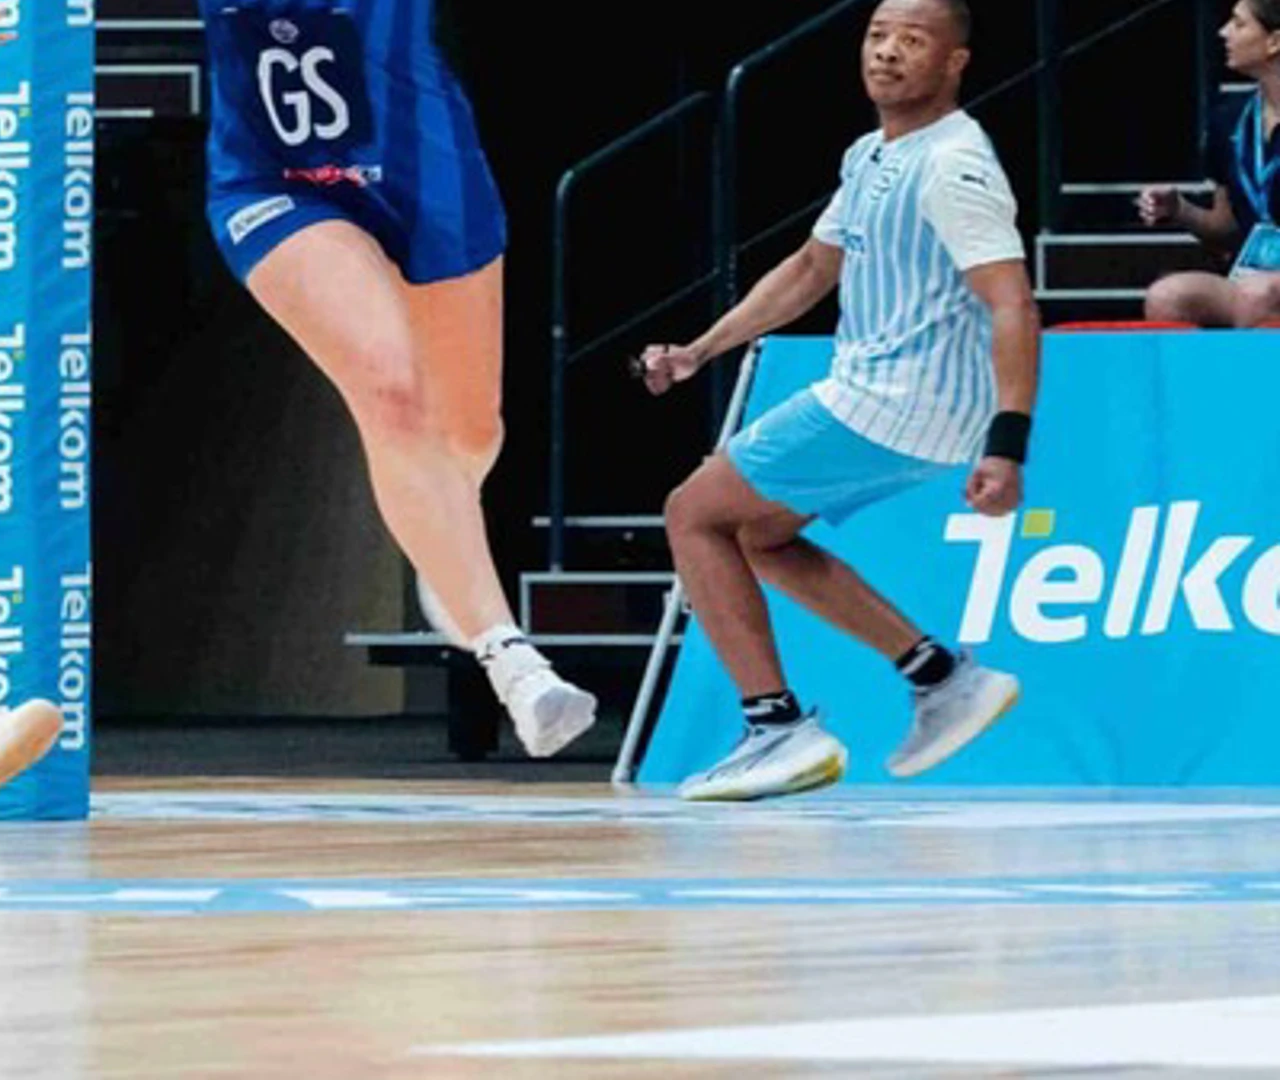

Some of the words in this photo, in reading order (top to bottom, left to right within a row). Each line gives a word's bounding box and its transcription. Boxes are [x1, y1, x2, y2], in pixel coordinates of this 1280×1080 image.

[257, 46, 351, 147] GS
[59, 320, 92, 510] Telkom
[58, 561, 92, 751] Telkom
